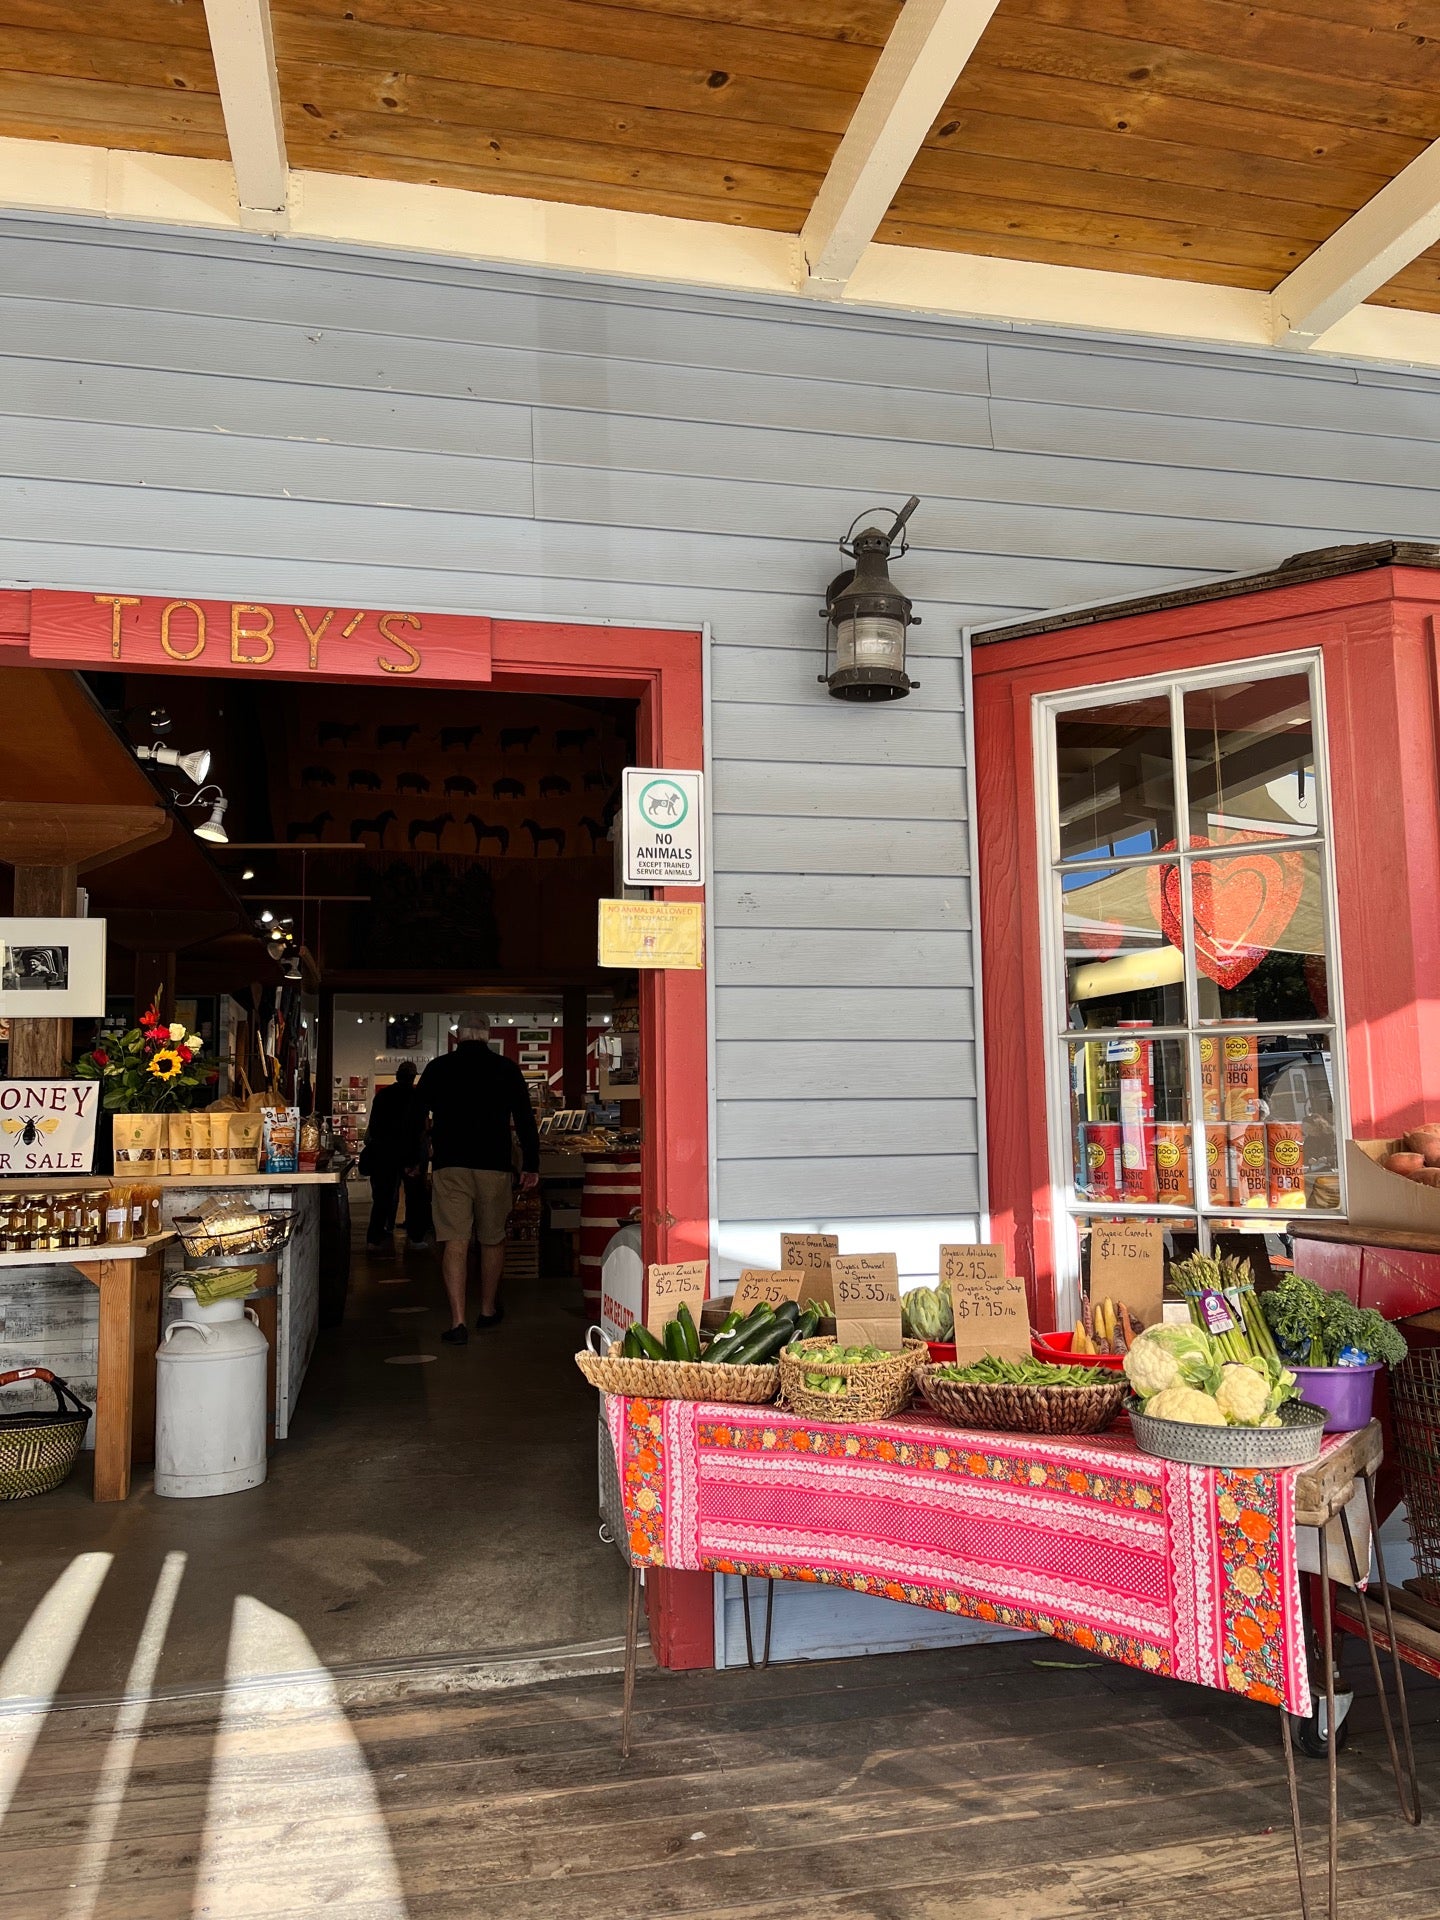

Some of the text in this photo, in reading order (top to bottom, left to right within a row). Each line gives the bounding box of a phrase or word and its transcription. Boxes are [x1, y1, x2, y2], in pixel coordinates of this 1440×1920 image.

[94, 595, 422, 673] TOBY'S
[656, 834, 672, 844] NO
[637, 847, 692, 859] ANIMALS
[1226, 1072, 1248, 1084] BBQ
[0, 1086, 92, 1117] ONEY
[25, 1153, 83, 1169] SALE
[1158, 1178, 1179, 1191] BBQ
[1277, 1177, 1300, 1189] BBQ
[1097, 1226, 1152, 1243] Organic Carrots
[783, 1236, 837, 1250] Organic Green Beans
[942, 1247, 964, 1260] Organic
[653, 1268, 674, 1280] Organic
[836, 1260, 859, 1274] Organic
[945, 1259, 987, 1279] $2.95
[745, 1272, 769, 1286] Organic
[957, 1283, 983, 1296] Organic
[985, 1281, 1005, 1295] Sugar
[974, 1293, 990, 1301] Peas
[604, 1294, 613, 1323] BAR
